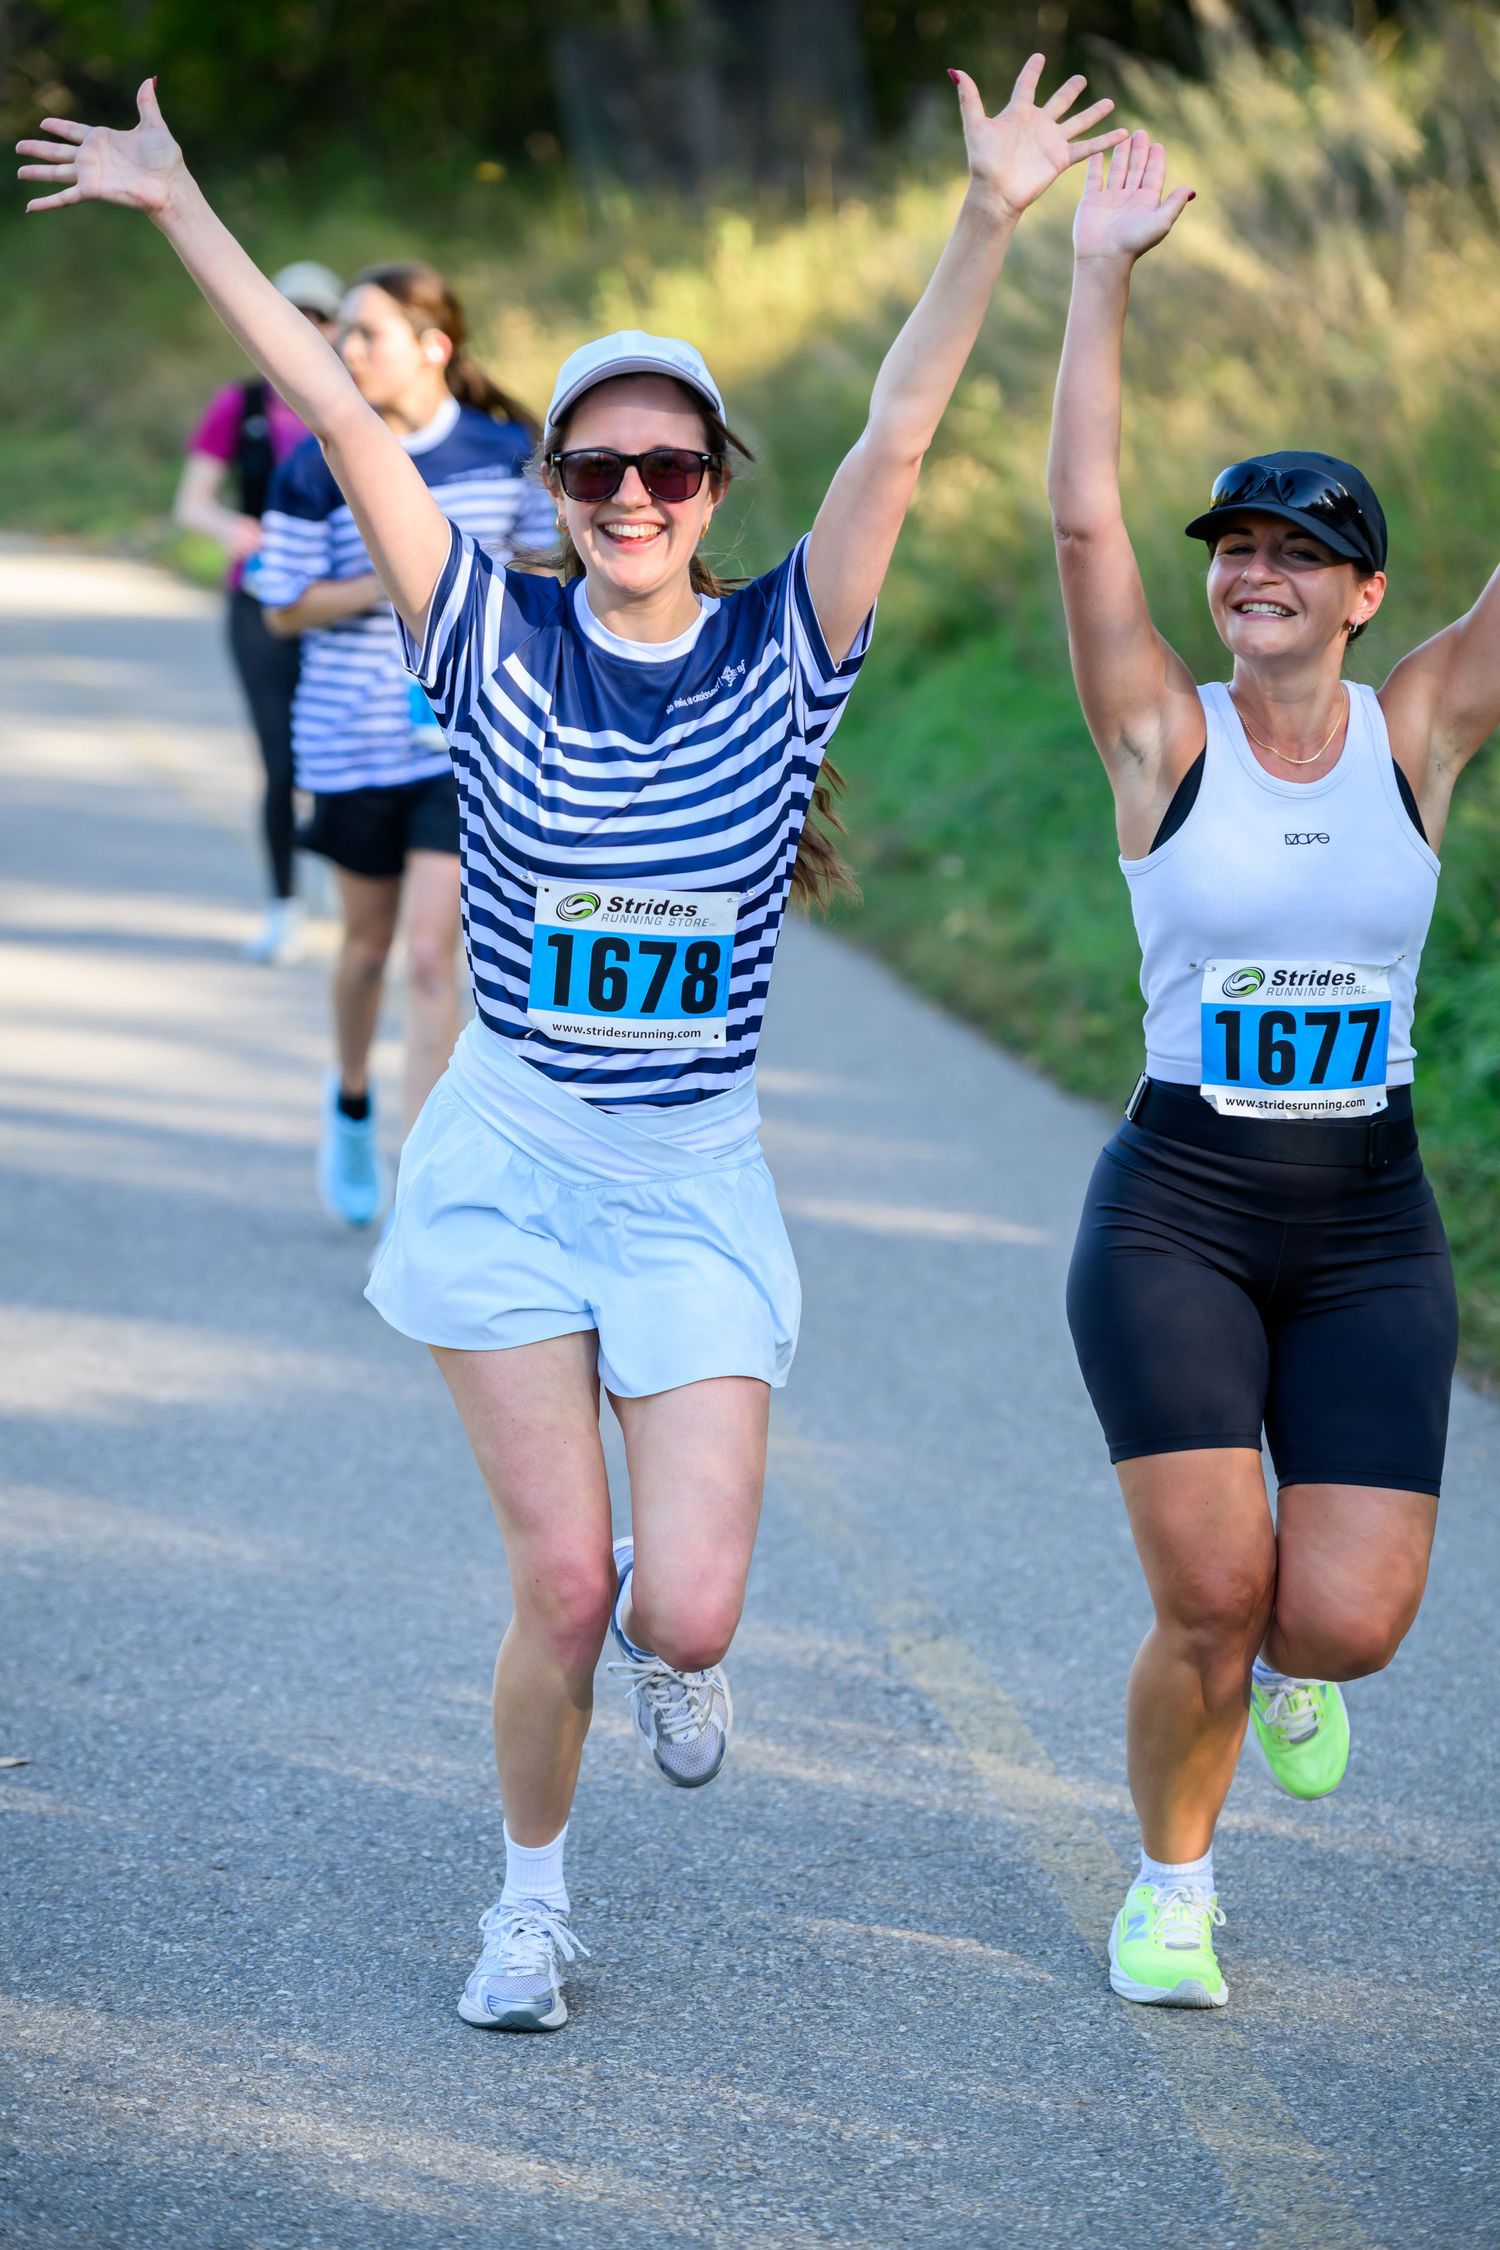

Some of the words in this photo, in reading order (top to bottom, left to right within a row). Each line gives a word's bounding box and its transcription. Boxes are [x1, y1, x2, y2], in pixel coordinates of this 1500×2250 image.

[607, 896, 698, 917] Strides
[600, 912, 663, 926] RUNNING
[668, 917, 710, 927] STORE
[547, 932, 721, 1015] 1678
[1271, 969, 1356, 986] Strides
[1266, 986, 1326, 997] RUNNING
[1331, 985, 1367, 996] STORE
[552, 1021, 702, 1041] www.stridesrunning.com
[1215, 1008, 1380, 1086] 1677
[1225, 1097, 1366, 1112] www.stridesrunning.com
